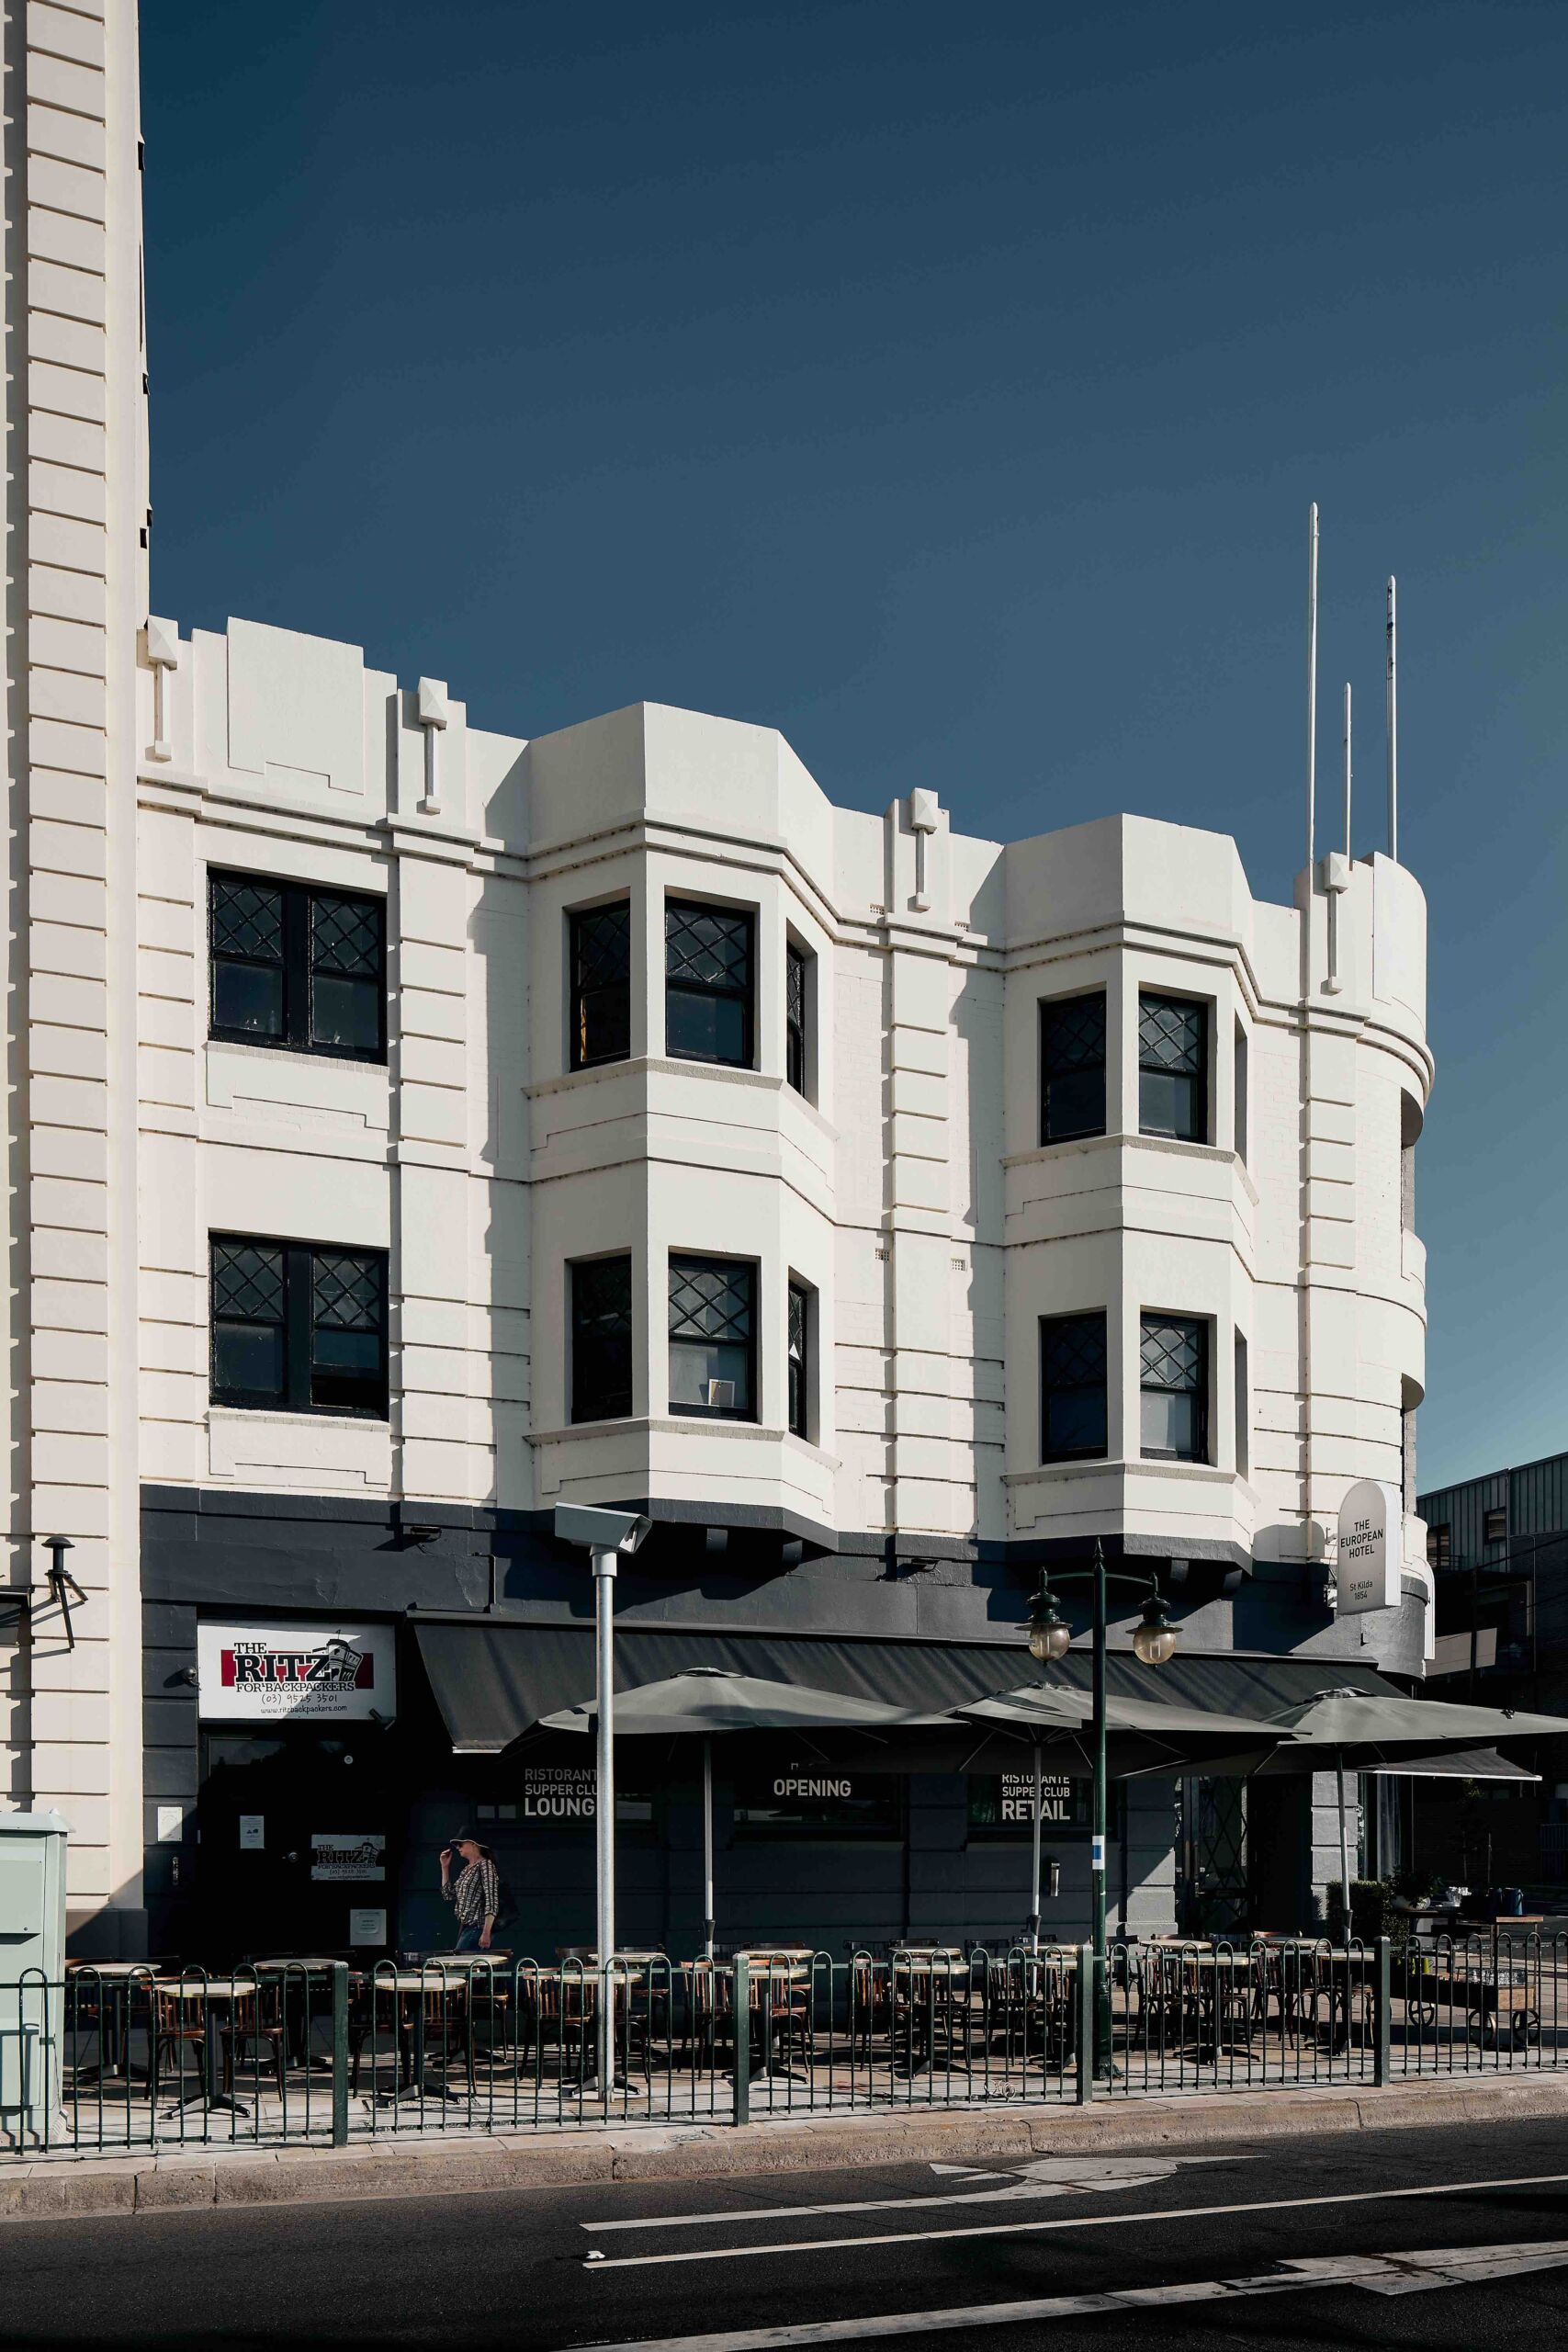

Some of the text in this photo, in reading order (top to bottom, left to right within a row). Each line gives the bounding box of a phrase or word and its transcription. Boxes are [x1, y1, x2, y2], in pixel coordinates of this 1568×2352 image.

[1354, 1519, 1371, 1532] THE
[1340, 1529, 1383, 1548] EUROPEAN
[1348, 1544, 1375, 1559] HOTEL
[1349, 1579, 1373, 1591] St Kilda
[1354, 1590, 1368, 1600] 1854
[234, 1643, 267, 1654] THE
[234, 1655, 332, 1682] RITZ
[236, 1682, 355, 1692] FOR BACKPACKERS
[261, 1693, 338, 1704] (03) 9525 3501
[260, 1704, 348, 1715] www.ritzbackpackers.com
[525, 1768, 598, 1781] RISTORANT
[525, 1783, 598, 1795] SUPPER CLU
[773, 1779, 852, 1797] OPENING
[1002, 1786, 1070, 1797] SUPPE CLUB
[525, 1797, 596, 1816] LOUNG
